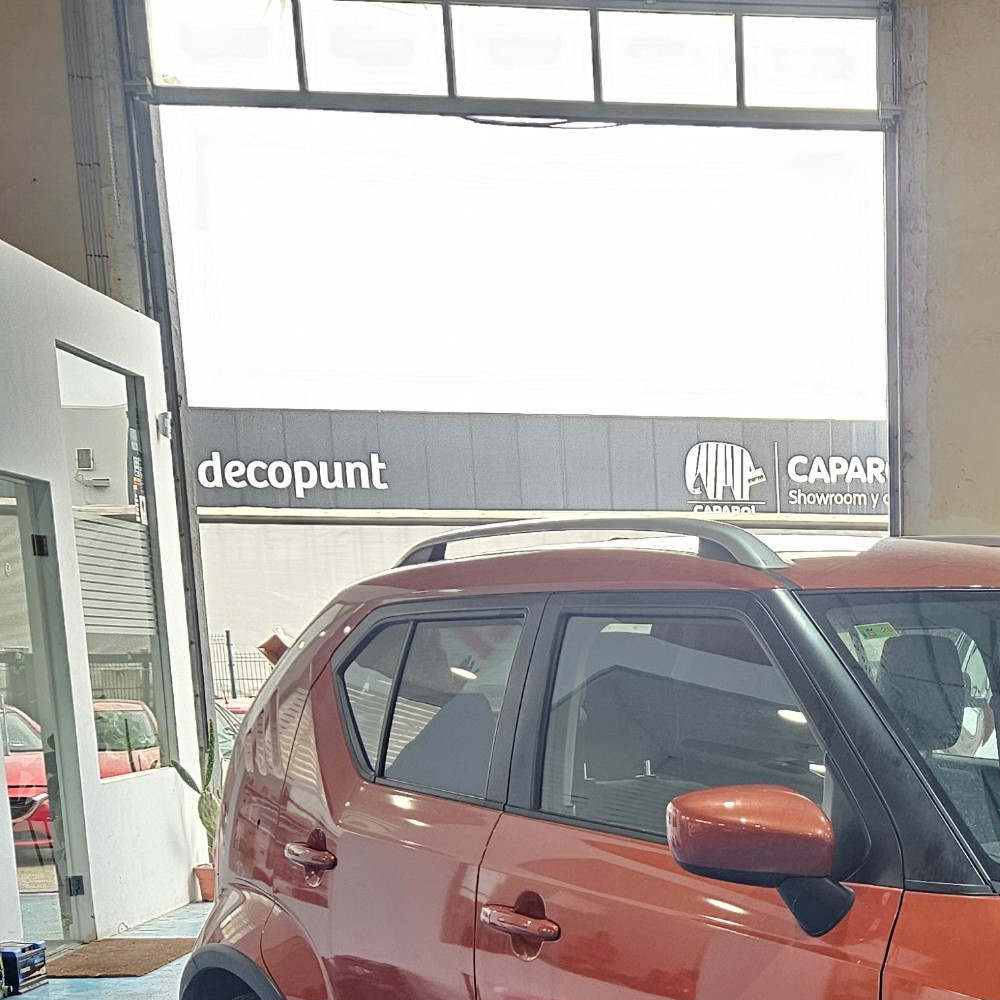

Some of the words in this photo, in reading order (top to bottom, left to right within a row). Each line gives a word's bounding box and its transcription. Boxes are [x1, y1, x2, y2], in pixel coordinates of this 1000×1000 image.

[198, 451, 388, 499] decopunt
[787, 455, 889, 484] CAPAR
[788, 489, 868, 506] Showroom
[871, 492, 880, 509] y
